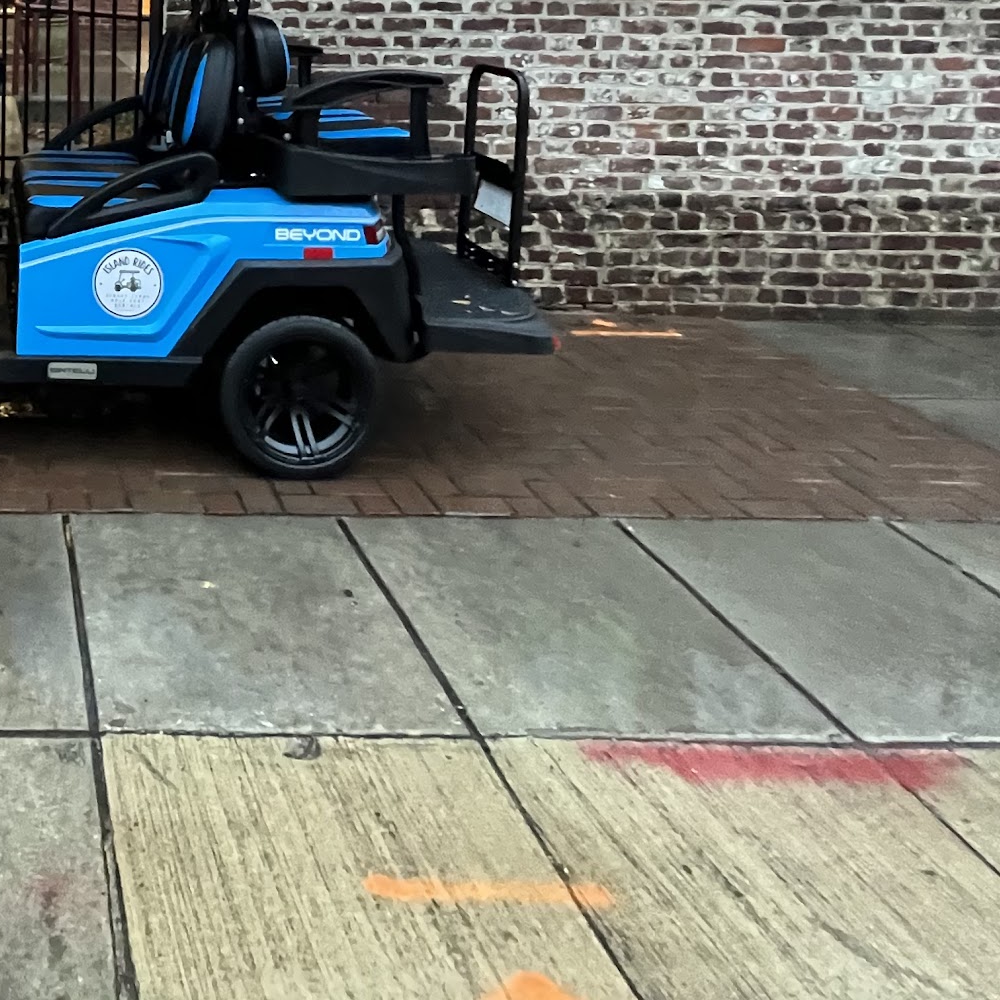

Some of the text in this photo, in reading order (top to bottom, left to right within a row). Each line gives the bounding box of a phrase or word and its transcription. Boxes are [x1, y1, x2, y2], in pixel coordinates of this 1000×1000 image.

[274, 227, 362, 242] BEYOND
[102, 256, 155, 276] ISLAND RIDES
